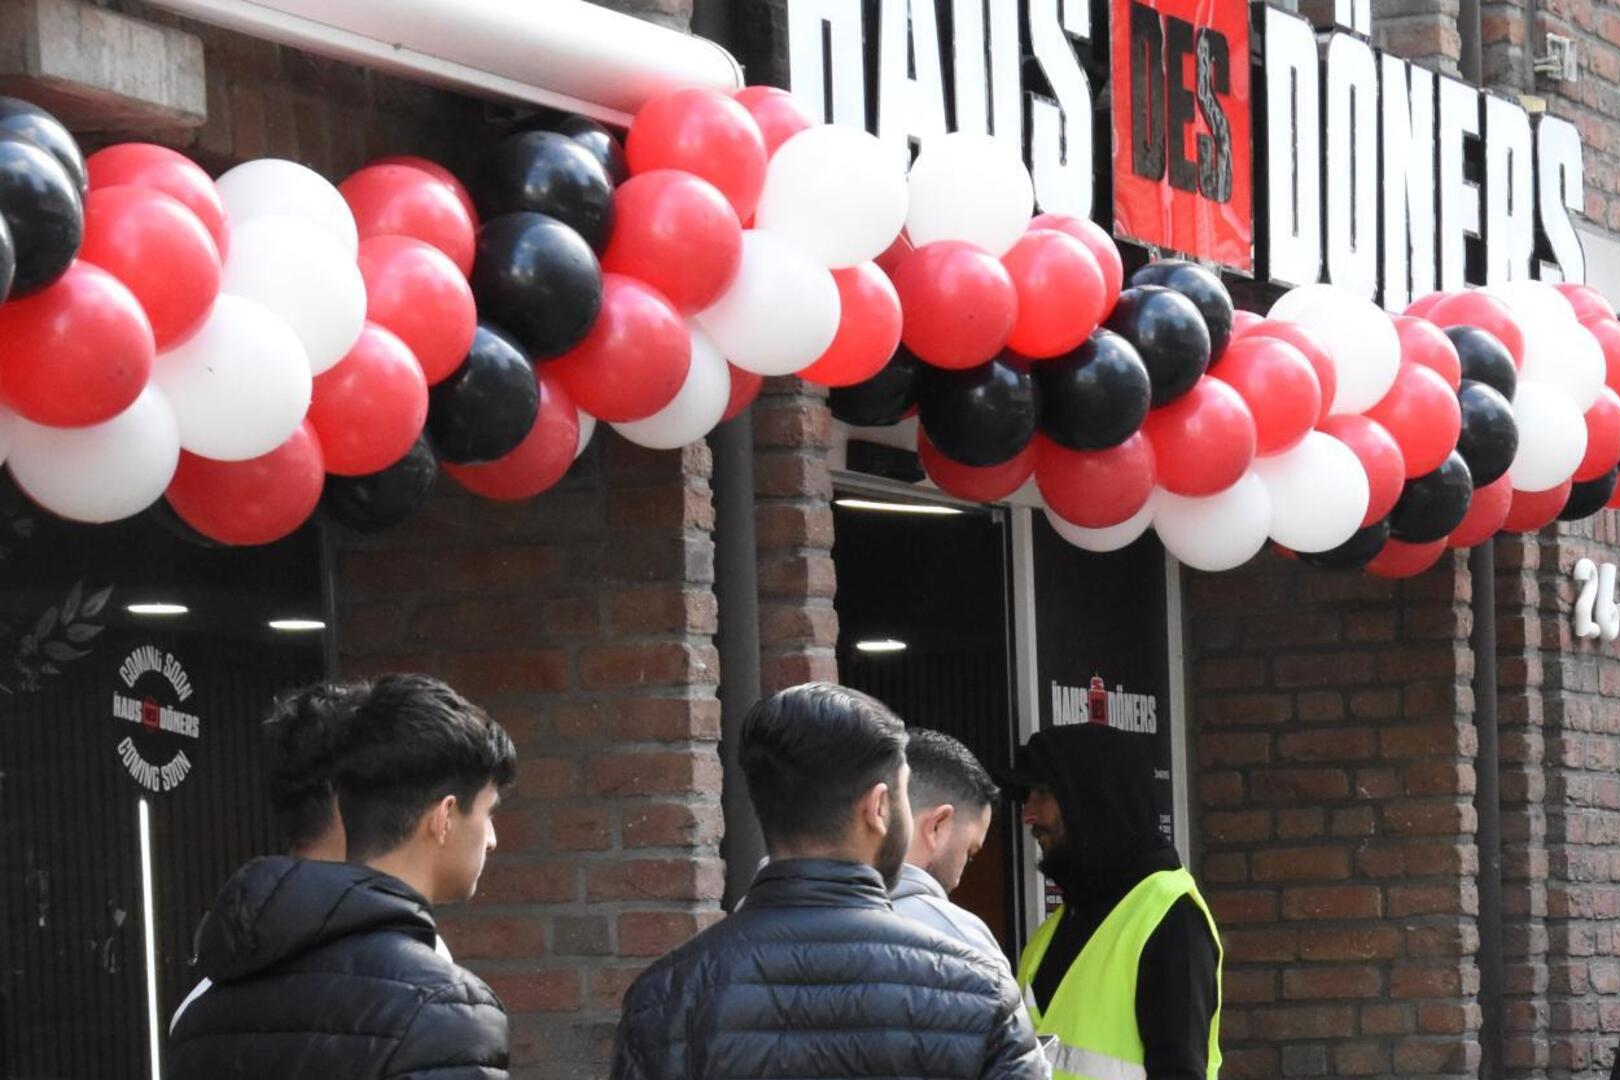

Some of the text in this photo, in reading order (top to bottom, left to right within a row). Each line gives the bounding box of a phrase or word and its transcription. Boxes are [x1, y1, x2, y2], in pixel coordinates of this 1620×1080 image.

[1130, 3, 1232, 204] DES
[1265, 0, 1585, 313] DÖNERS
[119, 645, 193, 701] COMING SOON
[113, 690, 143, 723] HAUS
[159, 705, 200, 739] DÖNERS
[1052, 680, 1089, 726] HAUS
[1108, 684, 1157, 734] DÖNERS
[117, 736, 192, 792] COMING SOON
